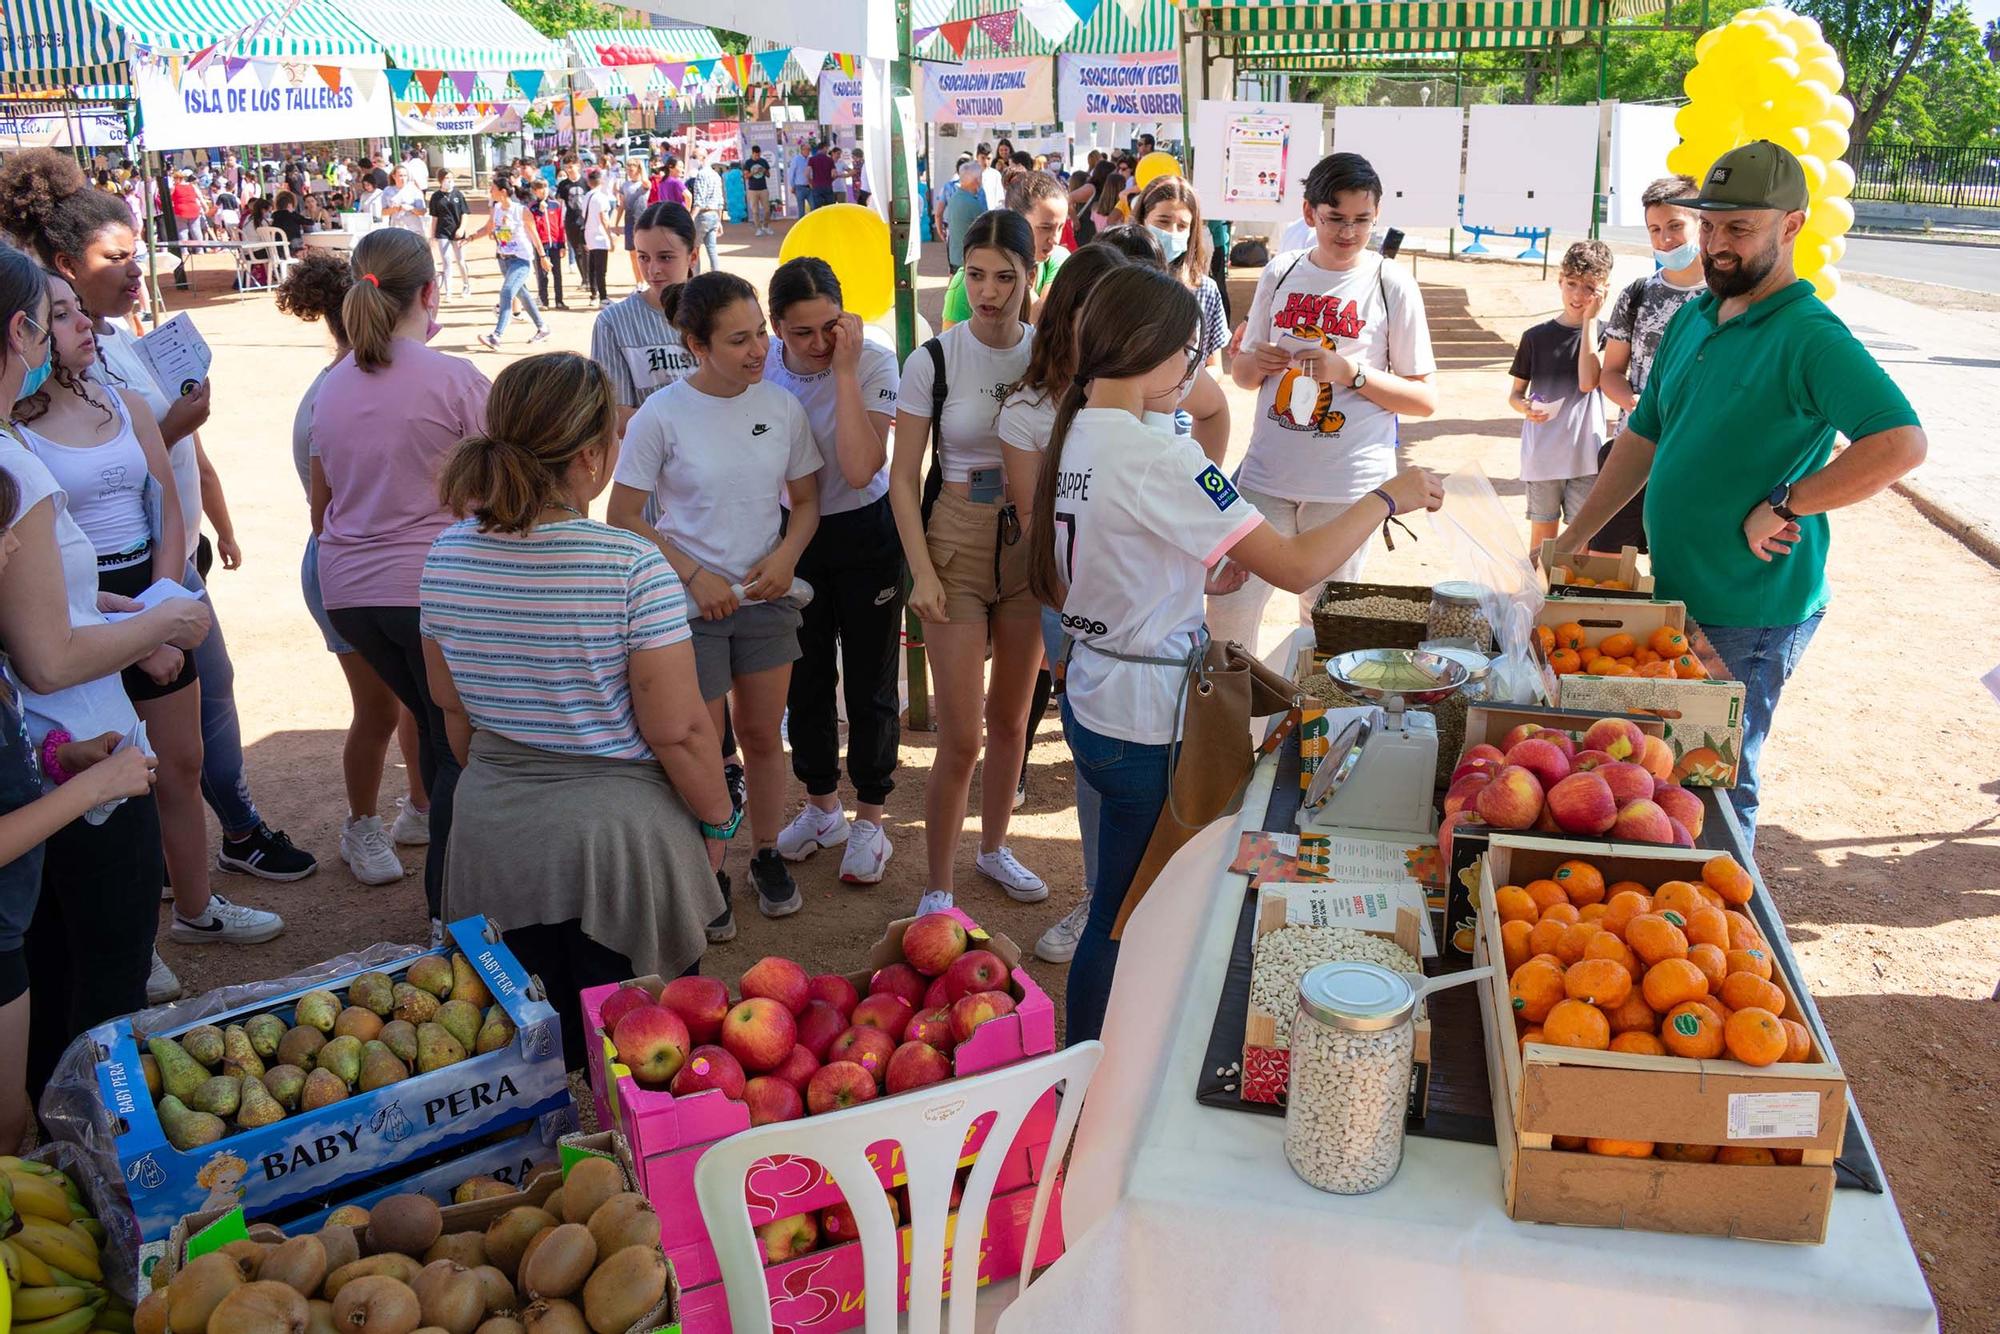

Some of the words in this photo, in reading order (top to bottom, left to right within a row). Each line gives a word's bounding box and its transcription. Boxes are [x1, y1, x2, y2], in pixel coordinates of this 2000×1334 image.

[939, 68, 989, 92] ASOCIACIÓN
[991, 71, 1026, 91] VECINAL
[1079, 61, 1147, 86] ASOCIACIÓN
[184, 88, 223, 114] ISLA
[227, 88, 247, 113] DE
[251, 87, 281, 112] LOS
[285, 86, 353, 111] TALLERES
[832, 80, 863, 97] ASOCIAC
[1086, 94, 1110, 114] SAN
[1110, 88, 1139, 114] JOSÉ
[956, 97, 1003, 116] SANTUARIO
[436, 121, 474, 131] SURESTE
[1284, 292, 1342, 316] HAVE
[1339, 299, 1358, 319] A
[1274, 309, 1320, 330] NICE
[1321, 314, 1367, 339] DAY
[478, 951, 502, 975] BABY
[493, 971, 517, 996] PERA
[108, 1062, 129, 1088] PERA
[114, 1089, 136, 1114] BABY
[259, 1123, 362, 1181] BABY
[423, 1074, 519, 1126] PERA
